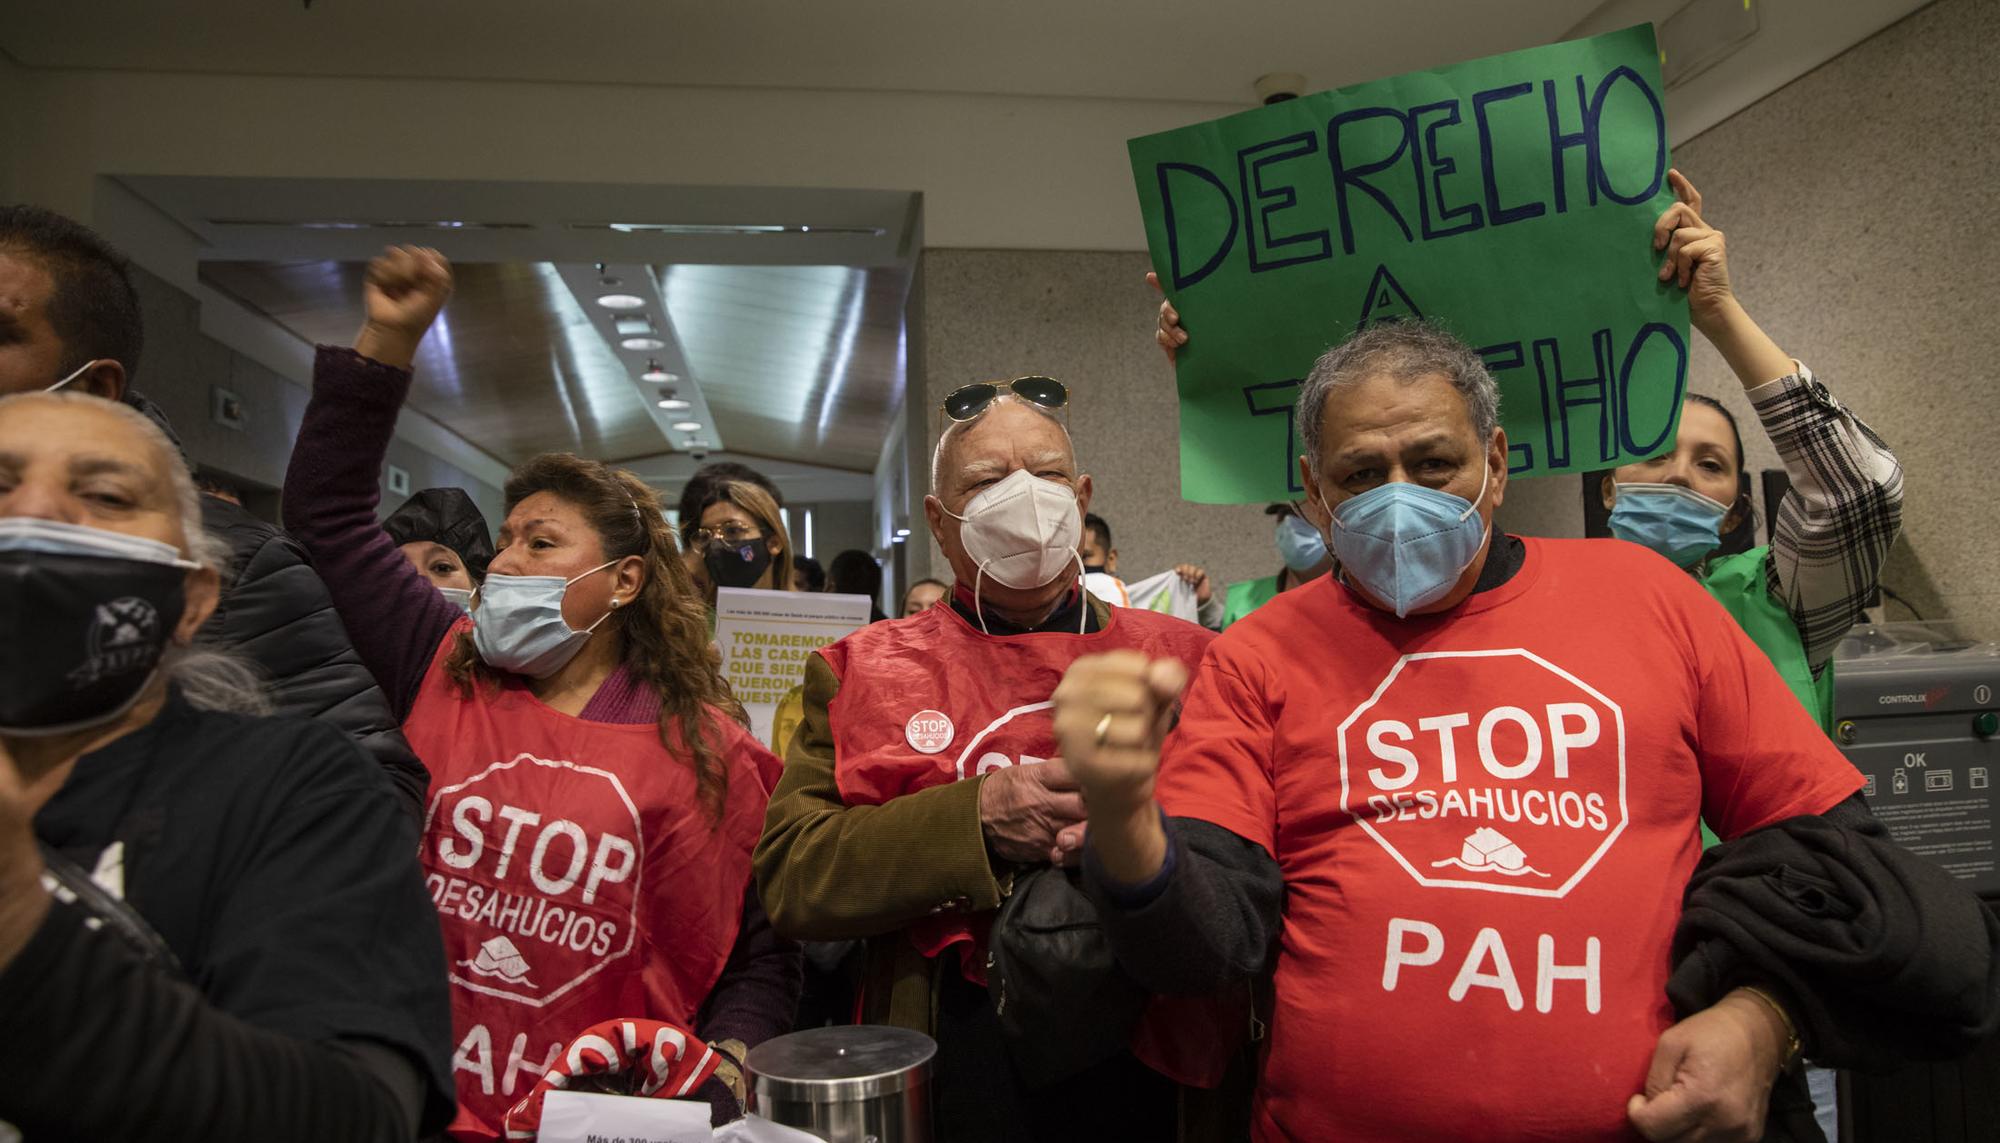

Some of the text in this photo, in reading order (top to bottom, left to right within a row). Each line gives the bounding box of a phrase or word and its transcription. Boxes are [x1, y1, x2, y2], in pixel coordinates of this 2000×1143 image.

[1156, 64, 1666, 291] DERECHO
[1356, 263, 1425, 334] A
[729, 661, 764, 674] QUE
[730, 646, 810, 661] LAS CASA
[731, 631, 836, 647] TOMAREMOS
[728, 675, 796, 690] FUERON
[911, 719, 948, 733] STOP
[1365, 702, 1601, 791] STOP
[1903, 752, 1928, 768] OK
[1367, 787, 1609, 832] DESAHUCIOS
[438, 795, 636, 905] STOP
[424, 872, 617, 957] DESAHUCIOS
[1381, 916, 1602, 1015] PAH
[452, 1023, 564, 1096] AH
